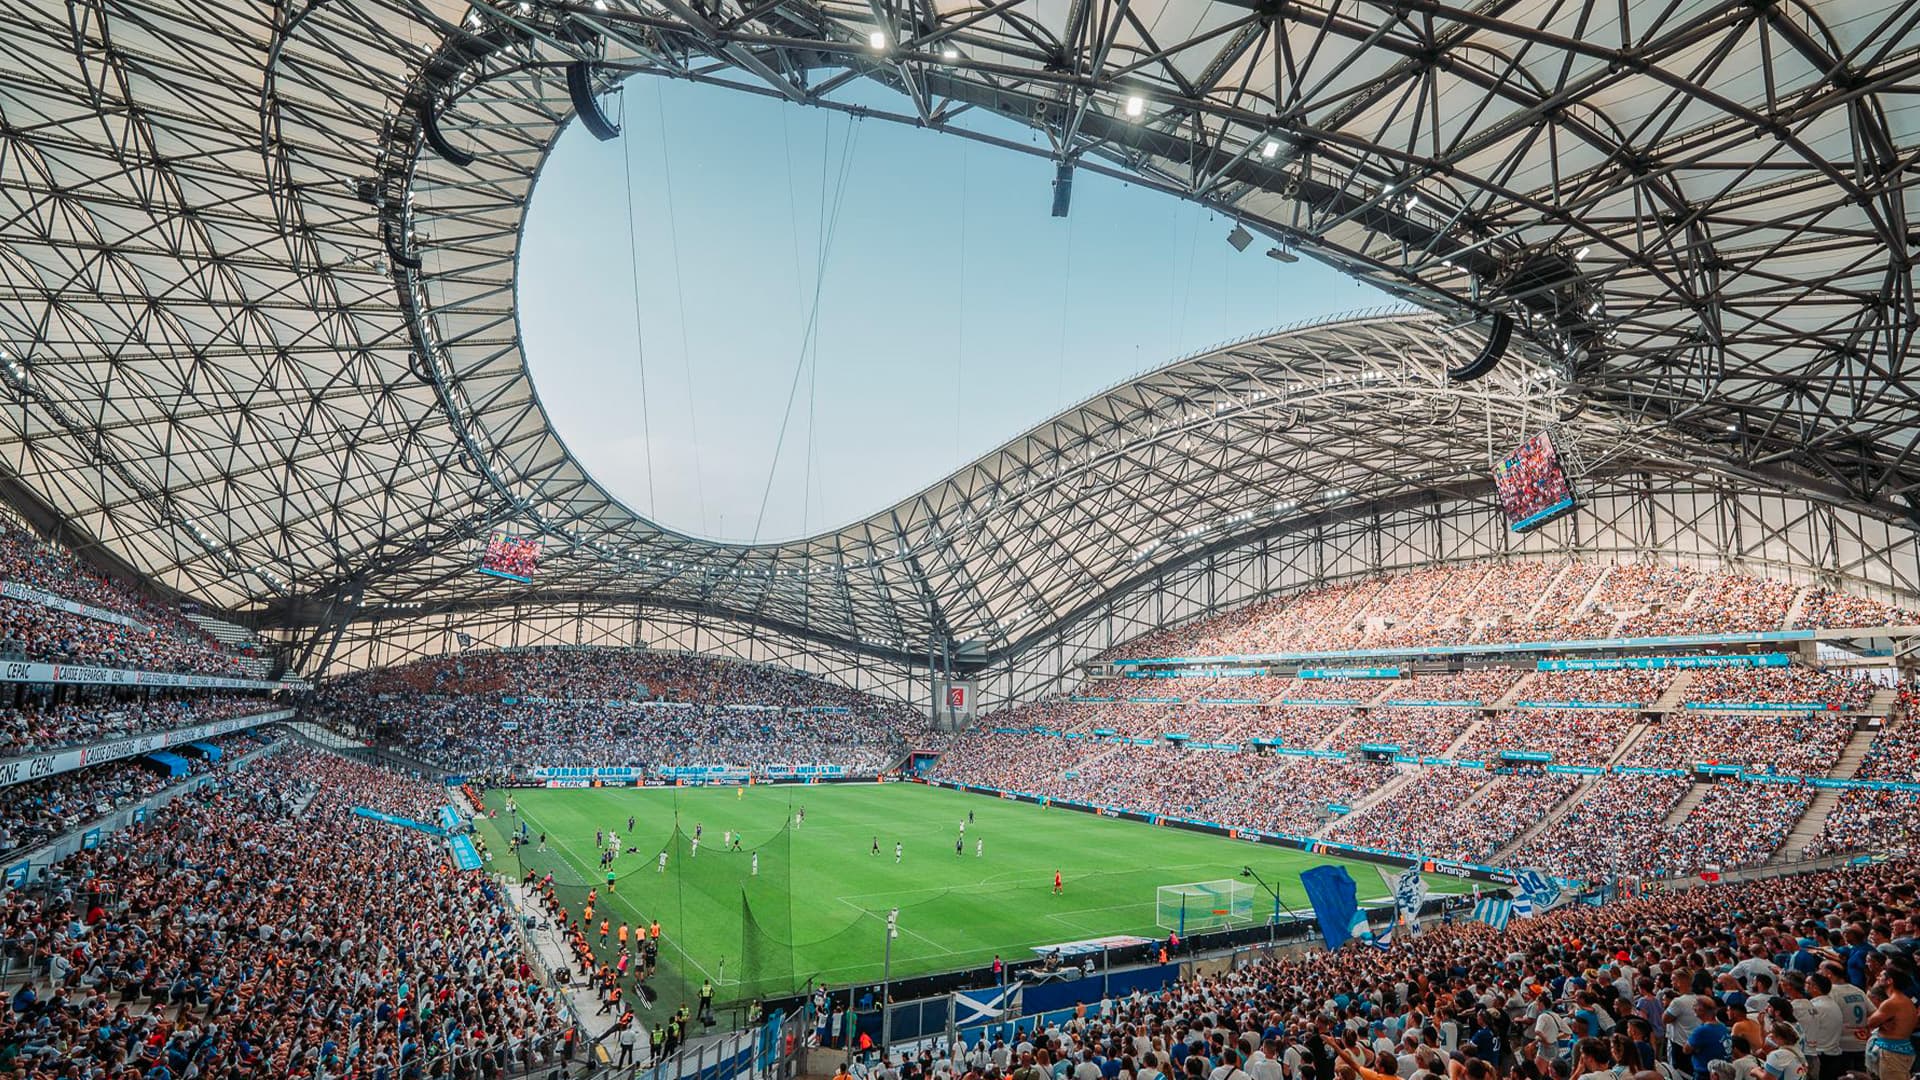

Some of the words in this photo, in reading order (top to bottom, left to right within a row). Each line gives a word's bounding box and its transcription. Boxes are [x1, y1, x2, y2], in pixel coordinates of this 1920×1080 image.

[7, 663, 31, 679] CEPAC
[60, 666, 80, 681] CAISSE
[86, 746, 107, 764] CAISSE
[105, 740, 135, 759] D'EPARGNE
[29, 755, 55, 777] CEPAC
[547, 767, 594, 777] VIRAGE
[598, 767, 632, 776] NORD
[559, 780, 582, 788] CEPAC
[1237, 831, 1261, 842] Orange
[1436, 863, 1471, 878] Orange
[1853, 1004, 1864, 1024] 9
